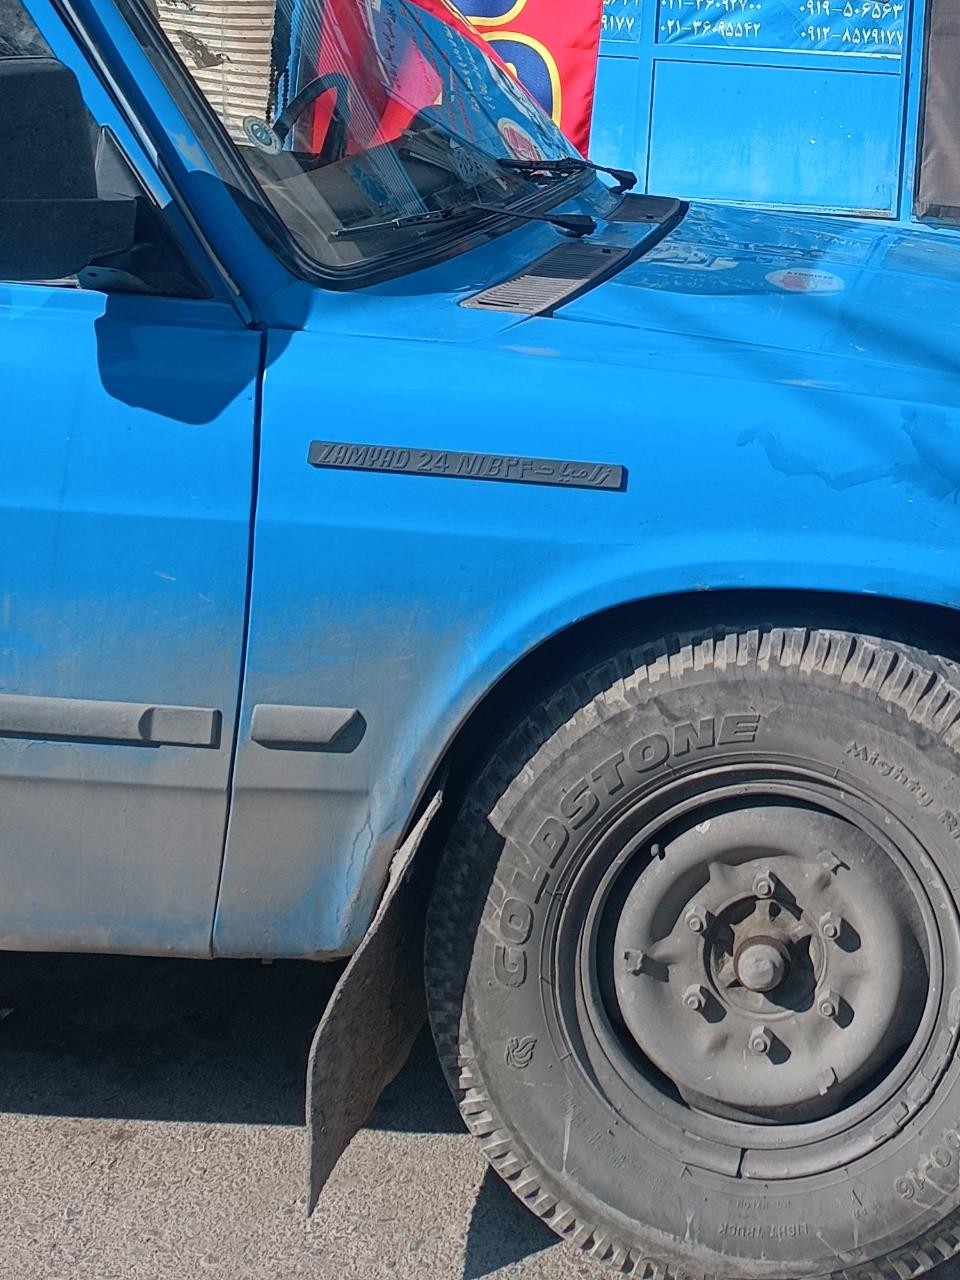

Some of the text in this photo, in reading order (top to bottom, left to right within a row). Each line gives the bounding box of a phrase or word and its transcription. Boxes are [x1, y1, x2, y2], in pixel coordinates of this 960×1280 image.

[800, 0, 903, 20] ۰۹۱۹-۵۰۶۵۶۳
[318, 443, 411, 470] ZAMYAD
[416, 450, 450, 472] 24
[493, 713, 761, 988] GOLDSTONE
